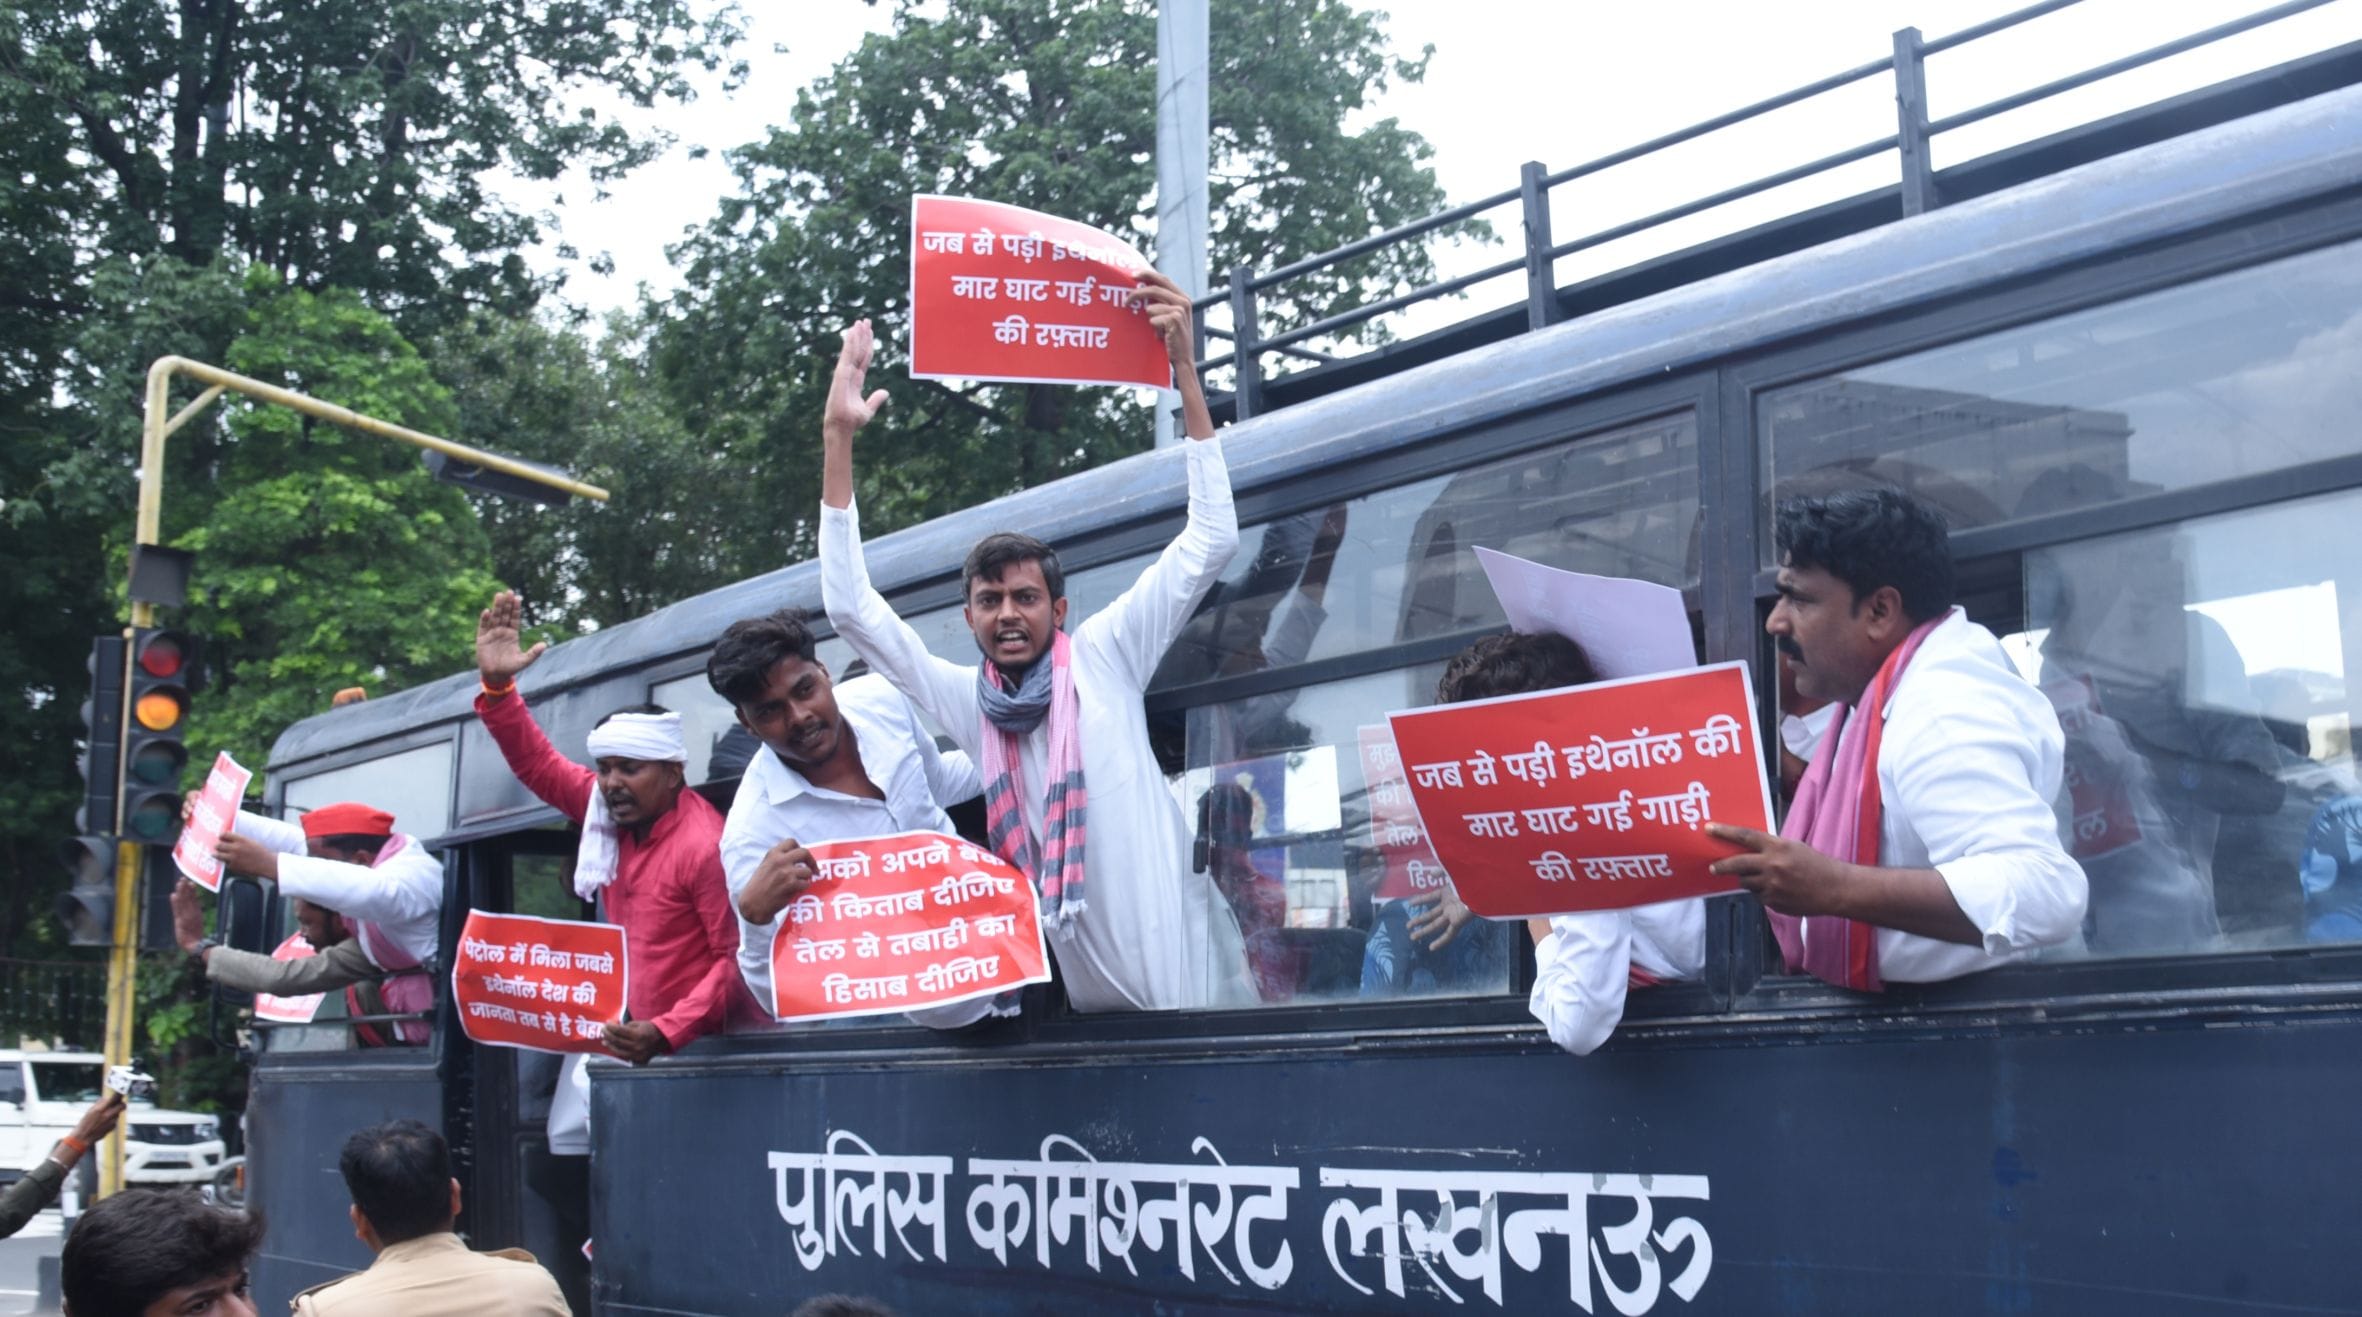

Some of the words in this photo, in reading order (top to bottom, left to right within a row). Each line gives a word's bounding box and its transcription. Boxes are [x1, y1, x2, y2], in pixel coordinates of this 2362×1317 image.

[922, 231, 966, 255] जब
[971, 227, 995, 257] से
[1001, 228, 1044, 264] पड़ी
[951, 275, 998, 301] मार
[1003, 278, 1049, 302] घाट
[1055, 275, 1097, 307] गई
[992, 313, 1029, 346] की
[1035, 322, 1110, 349] रफ़्तार
[1412, 760, 1463, 790] जब
[1467, 749, 1498, 787] से
[1501, 740, 1557, 789] पड़ी
[1561, 727, 1683, 779] इथेनॉल
[1689, 713, 1742, 759] की
[1462, 811, 1519, 839] मार
[1522, 805, 1578, 835] घाट
[1583, 789, 1634, 833] गई
[1638, 781, 1711, 831] गाड़ी
[881, 840, 951, 873] अपने
[1528, 850, 1576, 882] की
[1577, 853, 1673, 882] रफ़्तार
[789, 894, 825, 925] की
[831, 889, 924, 922] किताब
[930, 871, 1015, 906] दीजिए
[465, 936, 505, 964] पेट्रोल
[509, 941, 527, 966] में
[530, 943, 571, 970] मिला
[574, 951, 614, 975] जबसे
[792, 932, 846, 964] तेल
[852, 931, 881, 959] से
[887, 917, 969, 956] तबाही
[976, 913, 1016, 938] का
[482, 973, 538, 1000] इथेनॉल
[541, 978, 570, 1004] देश
[572, 981, 597, 1006] की
[822, 973, 908, 1003] हिसाब
[915, 955, 1000, 993] दीजिए
[517, 1009, 540, 1030] तब
[542, 1010, 556, 1033] से
[560, 1012, 571, 1037] है
[575, 1014, 605, 1039] बेहा
[768, 1129, 953, 1271] पुलिस
[966, 1133, 1300, 1291] कमिश्नरेट
[1319, 1167, 1713, 1317] लखनऊ
